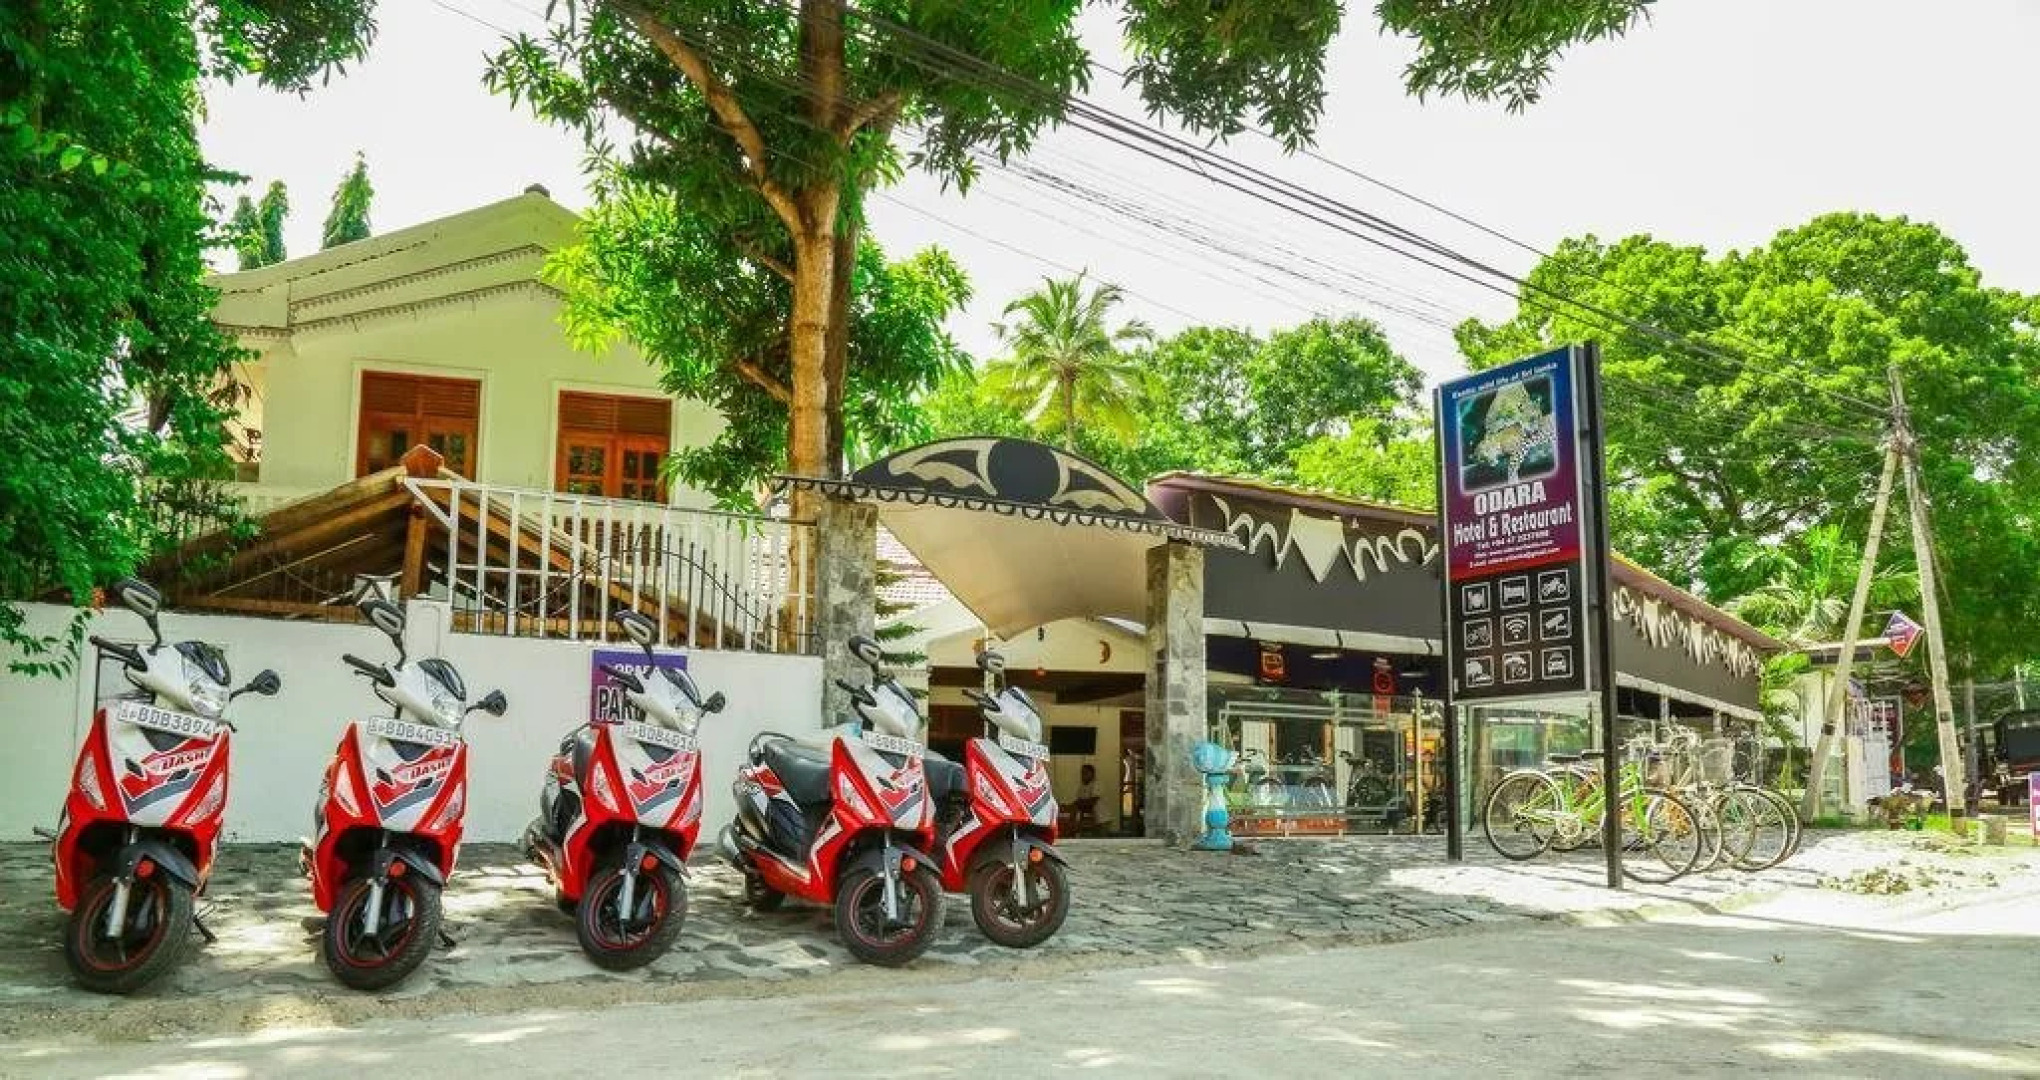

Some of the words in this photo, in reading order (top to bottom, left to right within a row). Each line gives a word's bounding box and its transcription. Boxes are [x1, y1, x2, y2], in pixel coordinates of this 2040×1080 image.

[1474, 481, 1547, 517] ODARA
[1454, 518, 1485, 547] Hotel
[1489, 515, 1498, 537] &
[1502, 501, 1572, 536] Restaurant
[139, 706, 212, 736] BDB3894
